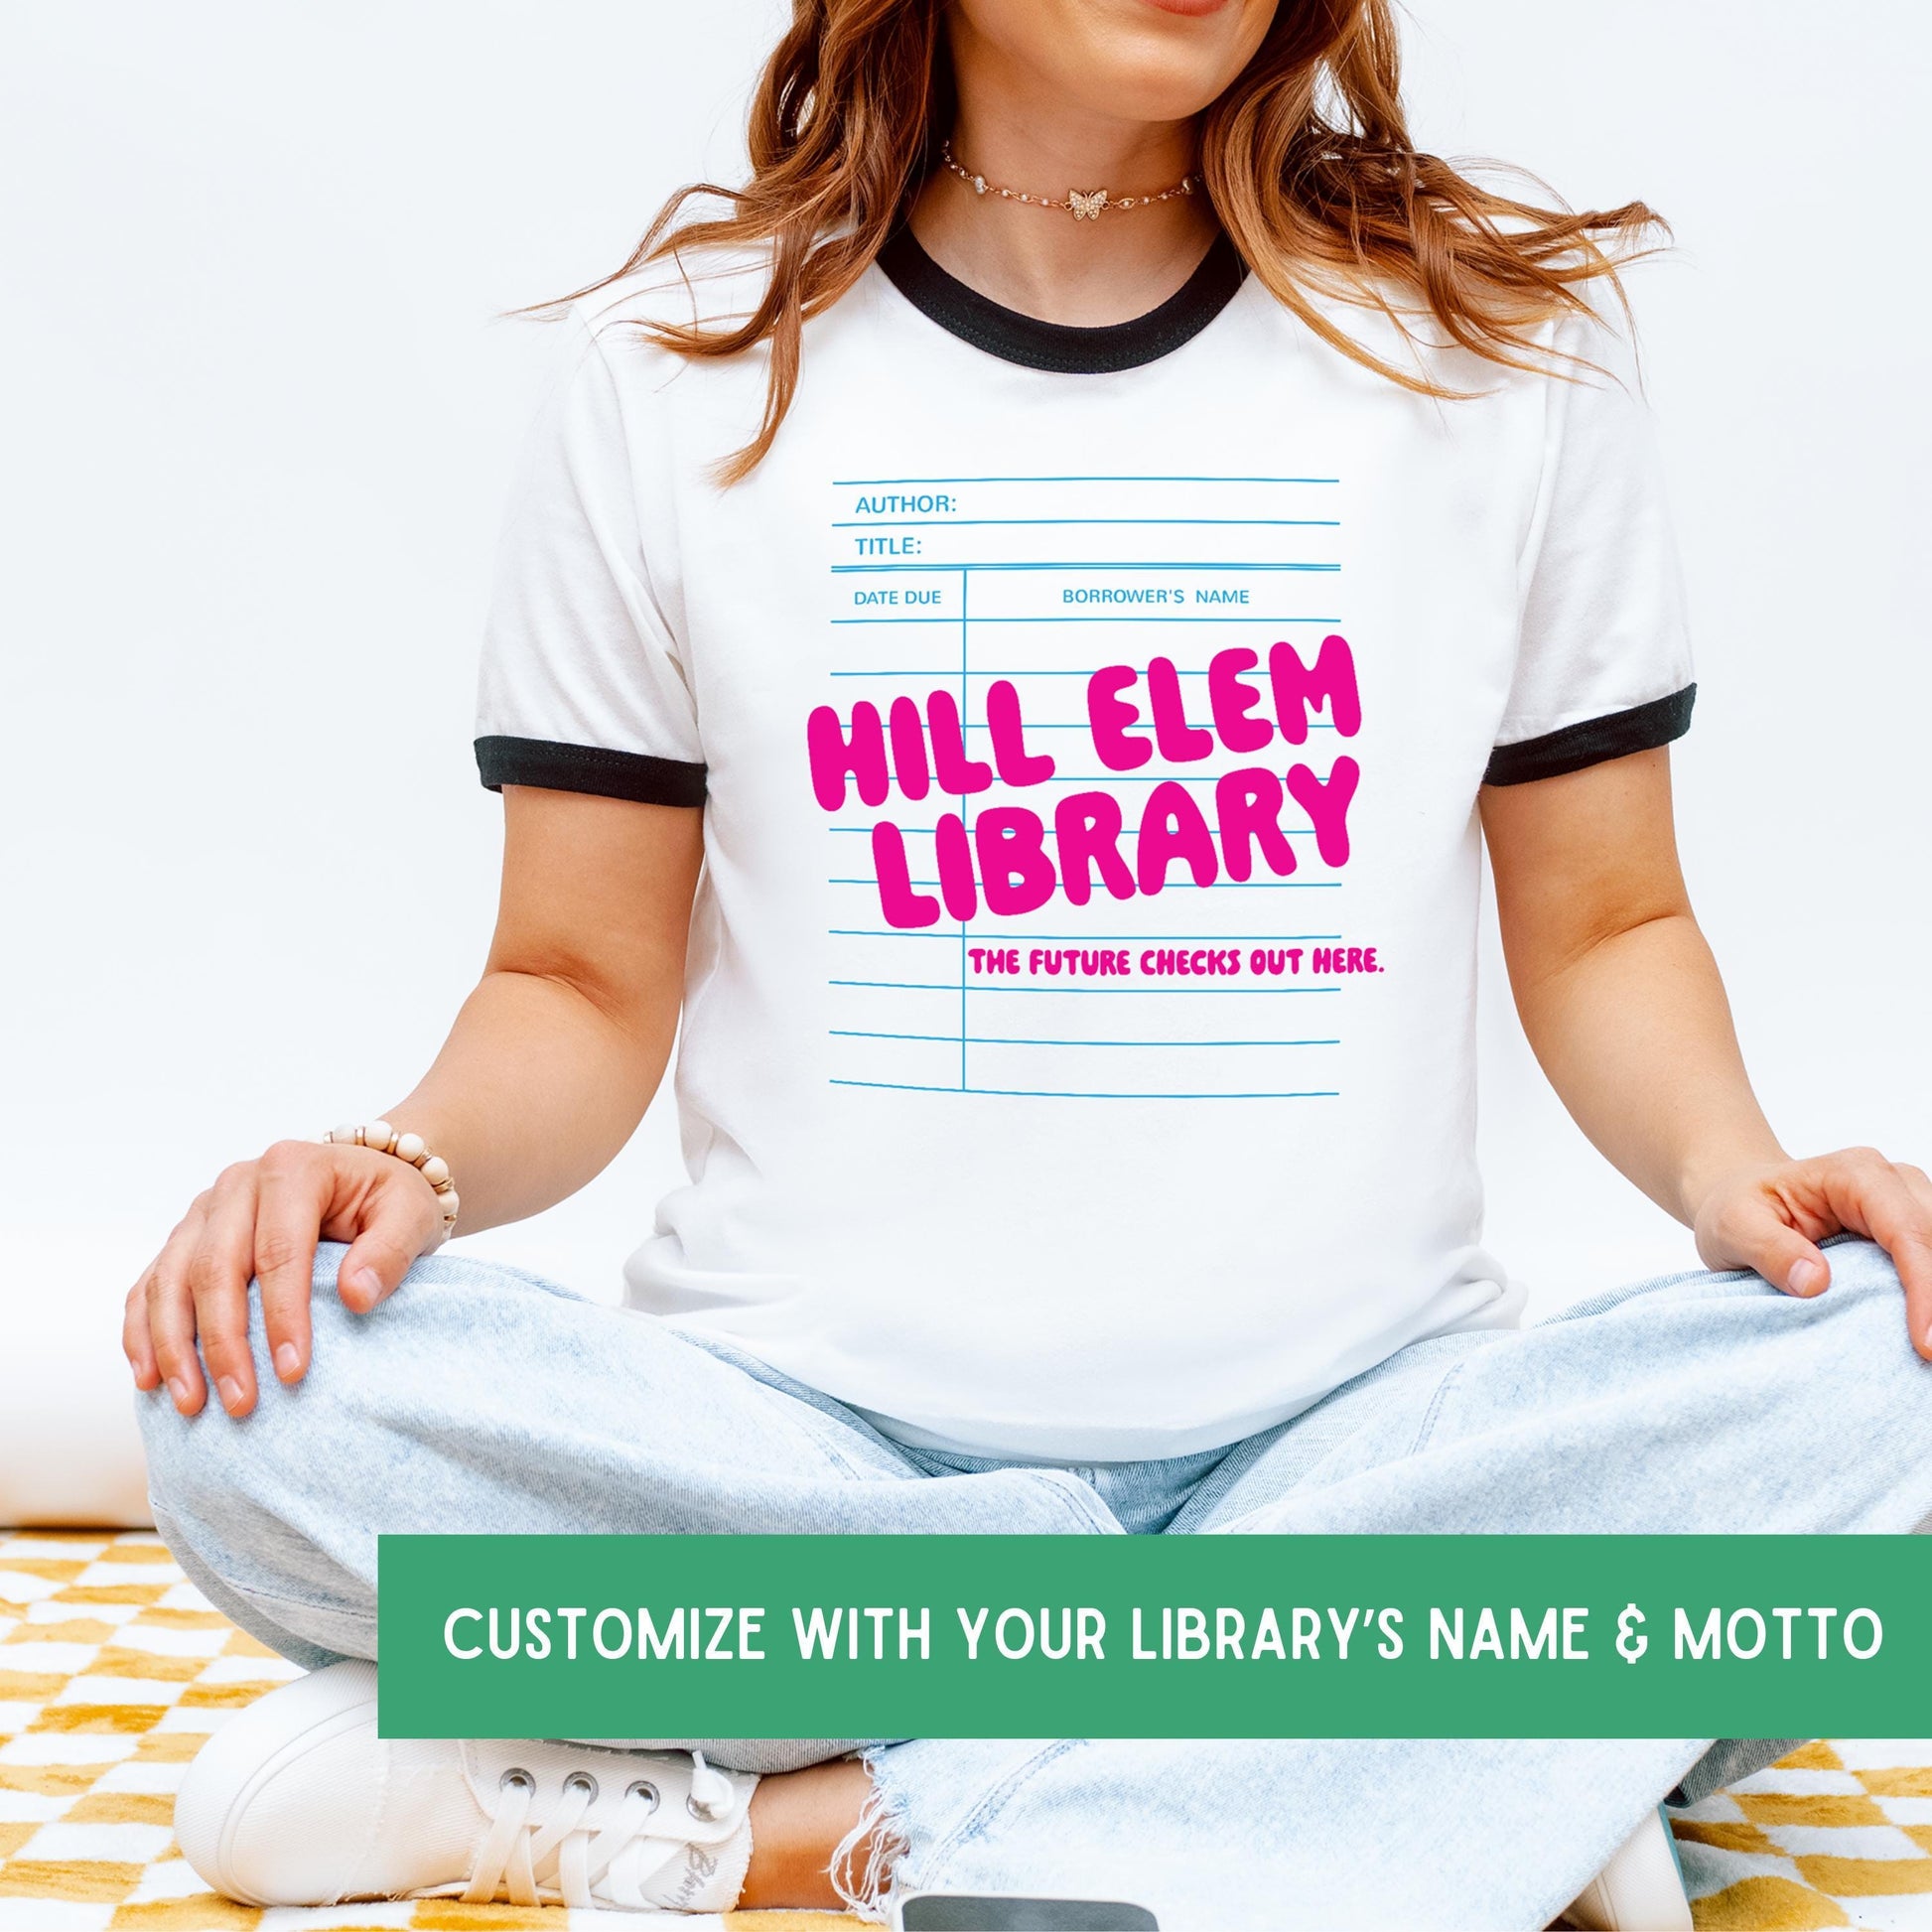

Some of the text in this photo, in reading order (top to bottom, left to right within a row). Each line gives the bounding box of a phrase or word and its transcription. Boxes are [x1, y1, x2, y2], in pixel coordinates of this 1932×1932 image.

[855, 495, 957, 514] AUTHOR:
[855, 537, 922, 556] TITLE:
[854, 590, 942, 606] DATE DUE
[1062, 589, 1250, 604] BORROWER'S NAME
[808, 635, 1361, 811] HILL ELEM
[873, 757, 1360, 928] LIBRARY
[968, 947, 1386, 976] THE FUTURE CHECKS OUT HERE.
